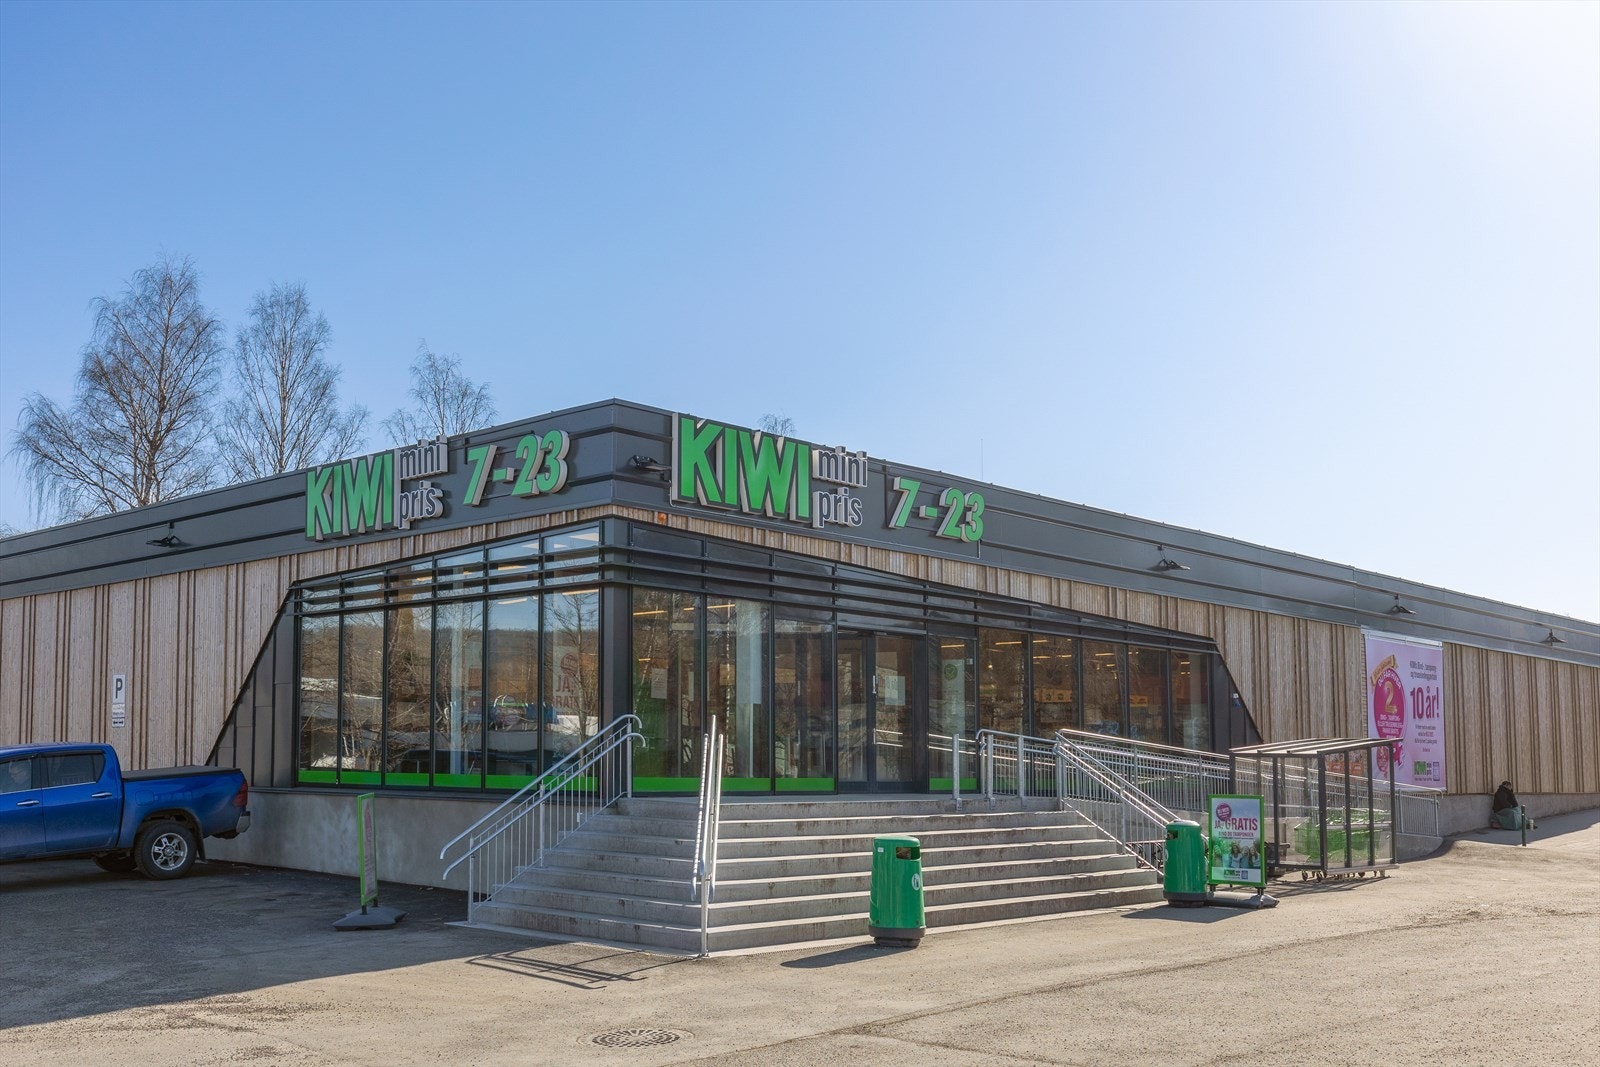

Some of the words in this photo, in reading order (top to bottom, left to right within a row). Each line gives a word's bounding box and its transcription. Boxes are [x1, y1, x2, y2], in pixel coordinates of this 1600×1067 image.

[399, 434, 449, 481] mini
[463, 429, 571, 507] 7-23
[672, 413, 812, 522] KIWI
[813, 446, 868, 488] mini
[306, 450, 397, 541] KIWI
[399, 480, 445, 530] pris
[813, 487, 864, 529] pris
[887, 477, 986, 543] 7-23
[115, 678, 123, 699] P
[1384, 680, 1398, 714] 2
[1409, 687, 1424, 720] 10
[1425, 685, 1440, 719] år!
[1225, 817, 1258, 831] GRATIS
